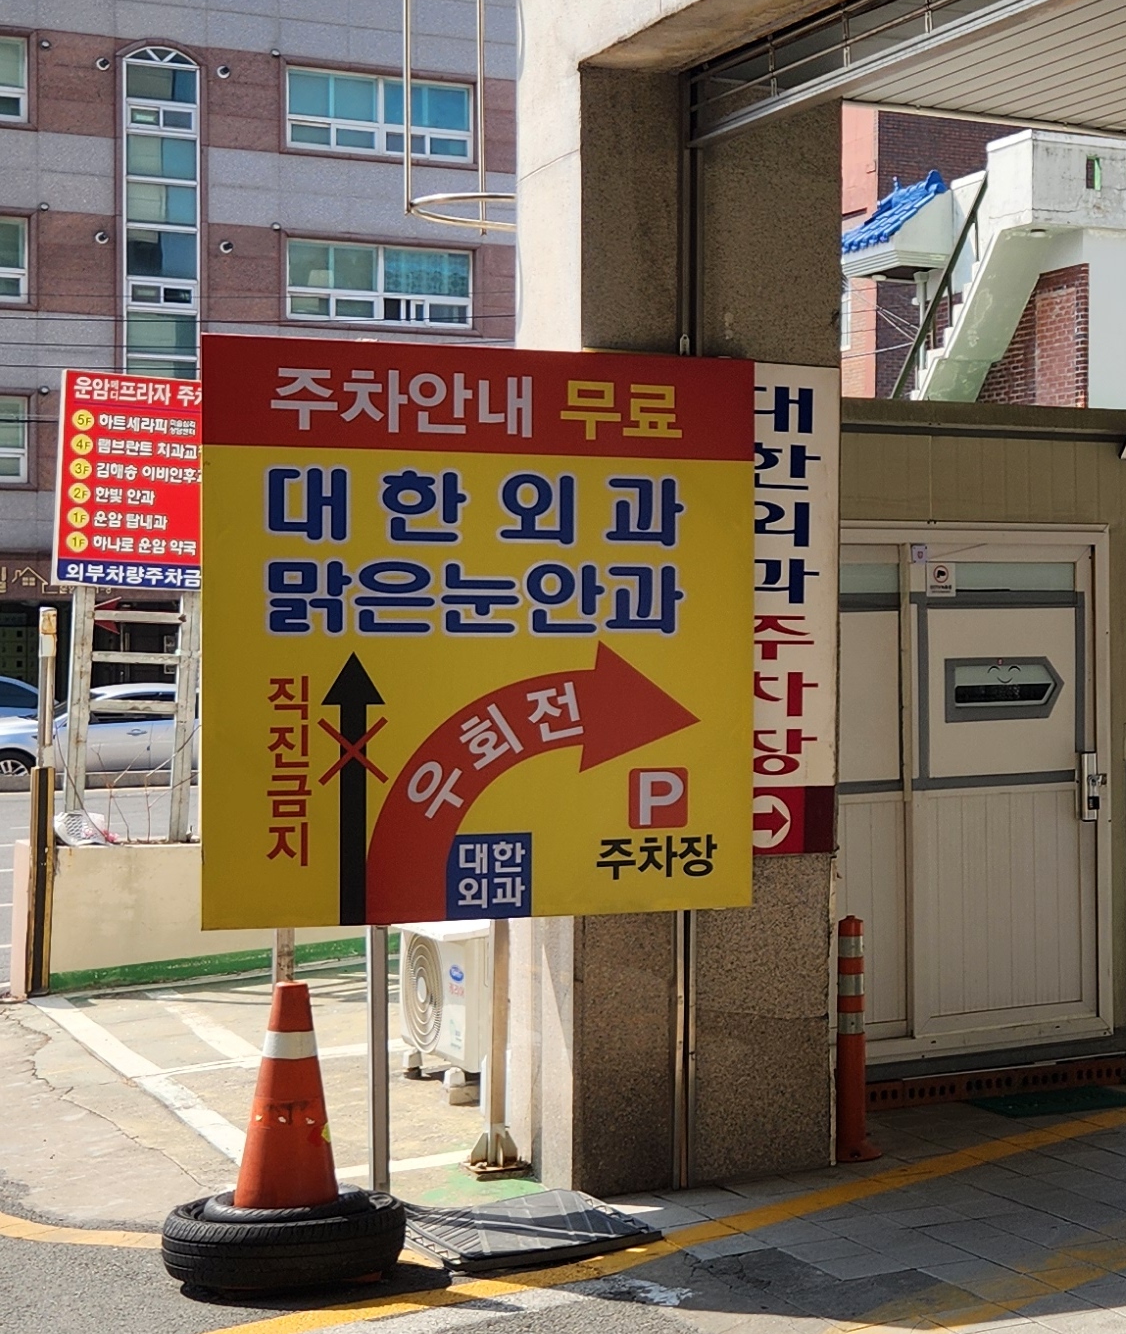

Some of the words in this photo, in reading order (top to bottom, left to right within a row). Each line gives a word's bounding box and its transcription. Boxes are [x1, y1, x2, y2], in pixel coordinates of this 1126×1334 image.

[77, 412, 92, 425] 5F
[270, 367, 532, 438] 주차안내
[560, 380, 683, 440] 무료
[76, 438, 91, 451] 4F
[157, 442, 202, 460] 치과교
[74, 463, 89, 475] 3F
[73, 488, 88, 500] 2F
[127, 489, 155, 505] 안과
[73, 511, 86, 523] 1F
[94, 511, 122, 528] 운암
[72, 536, 85, 548] 1F
[93, 535, 134, 552] 하나로
[139, 537, 166, 554] 운암
[170, 540, 196, 556] 약국
[267, 560, 686, 635] 맑은눈안과
[407, 681, 585, 819] 우회전
[267, 675, 312, 867] 직진금지
[638, 771, 685, 826] P
[458, 841, 526, 875] 대한
[596, 833, 718, 880] 주차장
[457, 876, 526, 909] 외과
